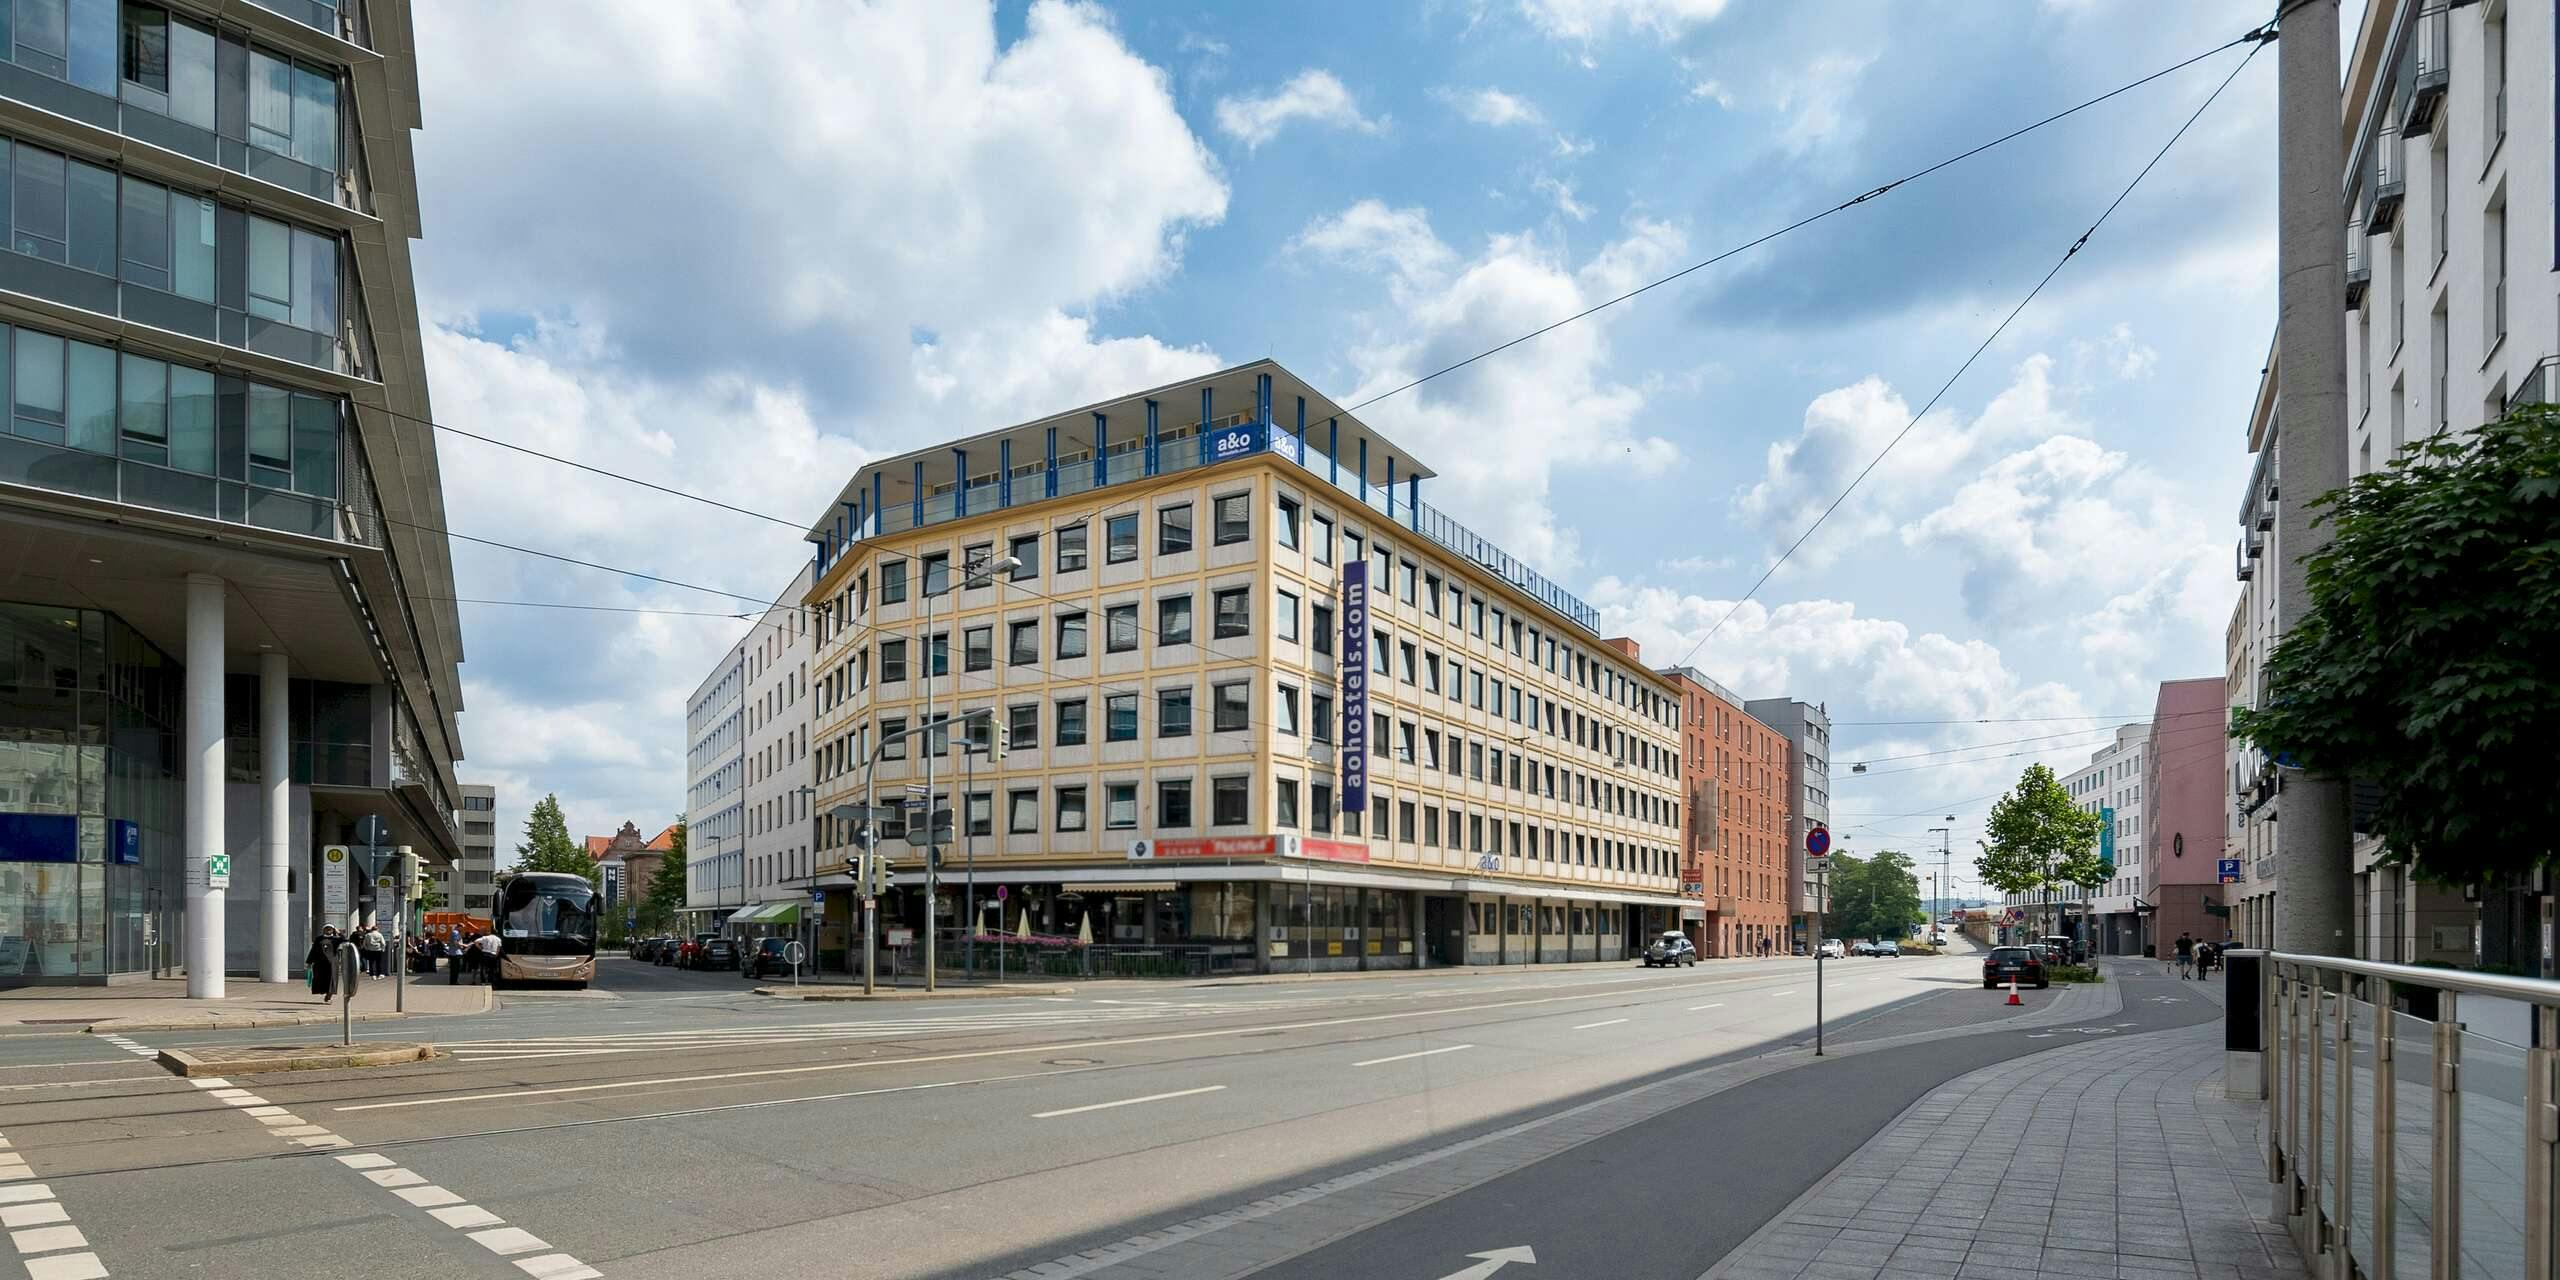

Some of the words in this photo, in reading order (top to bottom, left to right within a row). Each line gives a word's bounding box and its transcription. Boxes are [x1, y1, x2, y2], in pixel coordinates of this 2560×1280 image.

[1218, 432, 1250, 451] a&o
[1274, 437, 1295, 456] a&o
[1343, 582, 1363, 789] aohostels.com
[2225, 863, 2234, 872] P
[815, 892, 823, 901] P
